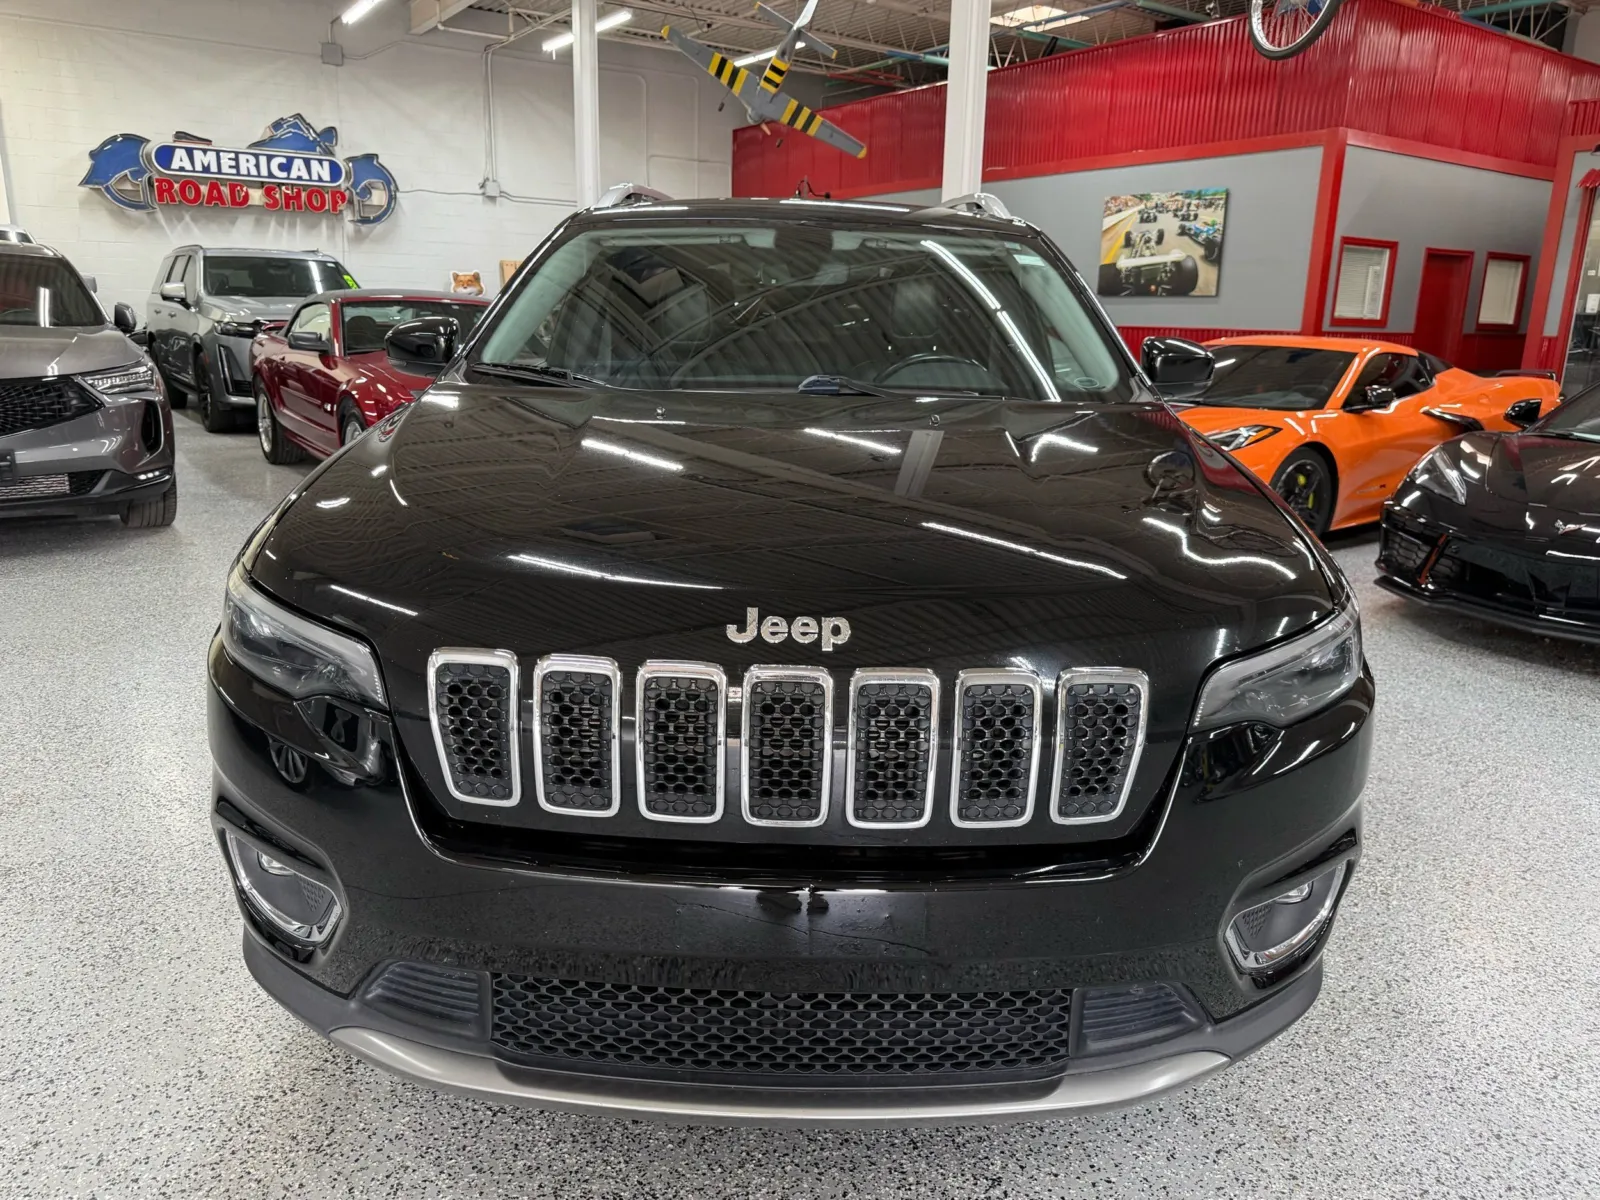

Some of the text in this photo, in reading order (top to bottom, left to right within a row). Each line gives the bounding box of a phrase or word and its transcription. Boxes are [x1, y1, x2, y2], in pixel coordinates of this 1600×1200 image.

[170, 148, 332, 182] AMERICAN
[154, 177, 348, 214] ROAD SHOP
[726, 606, 851, 651] Jeep
